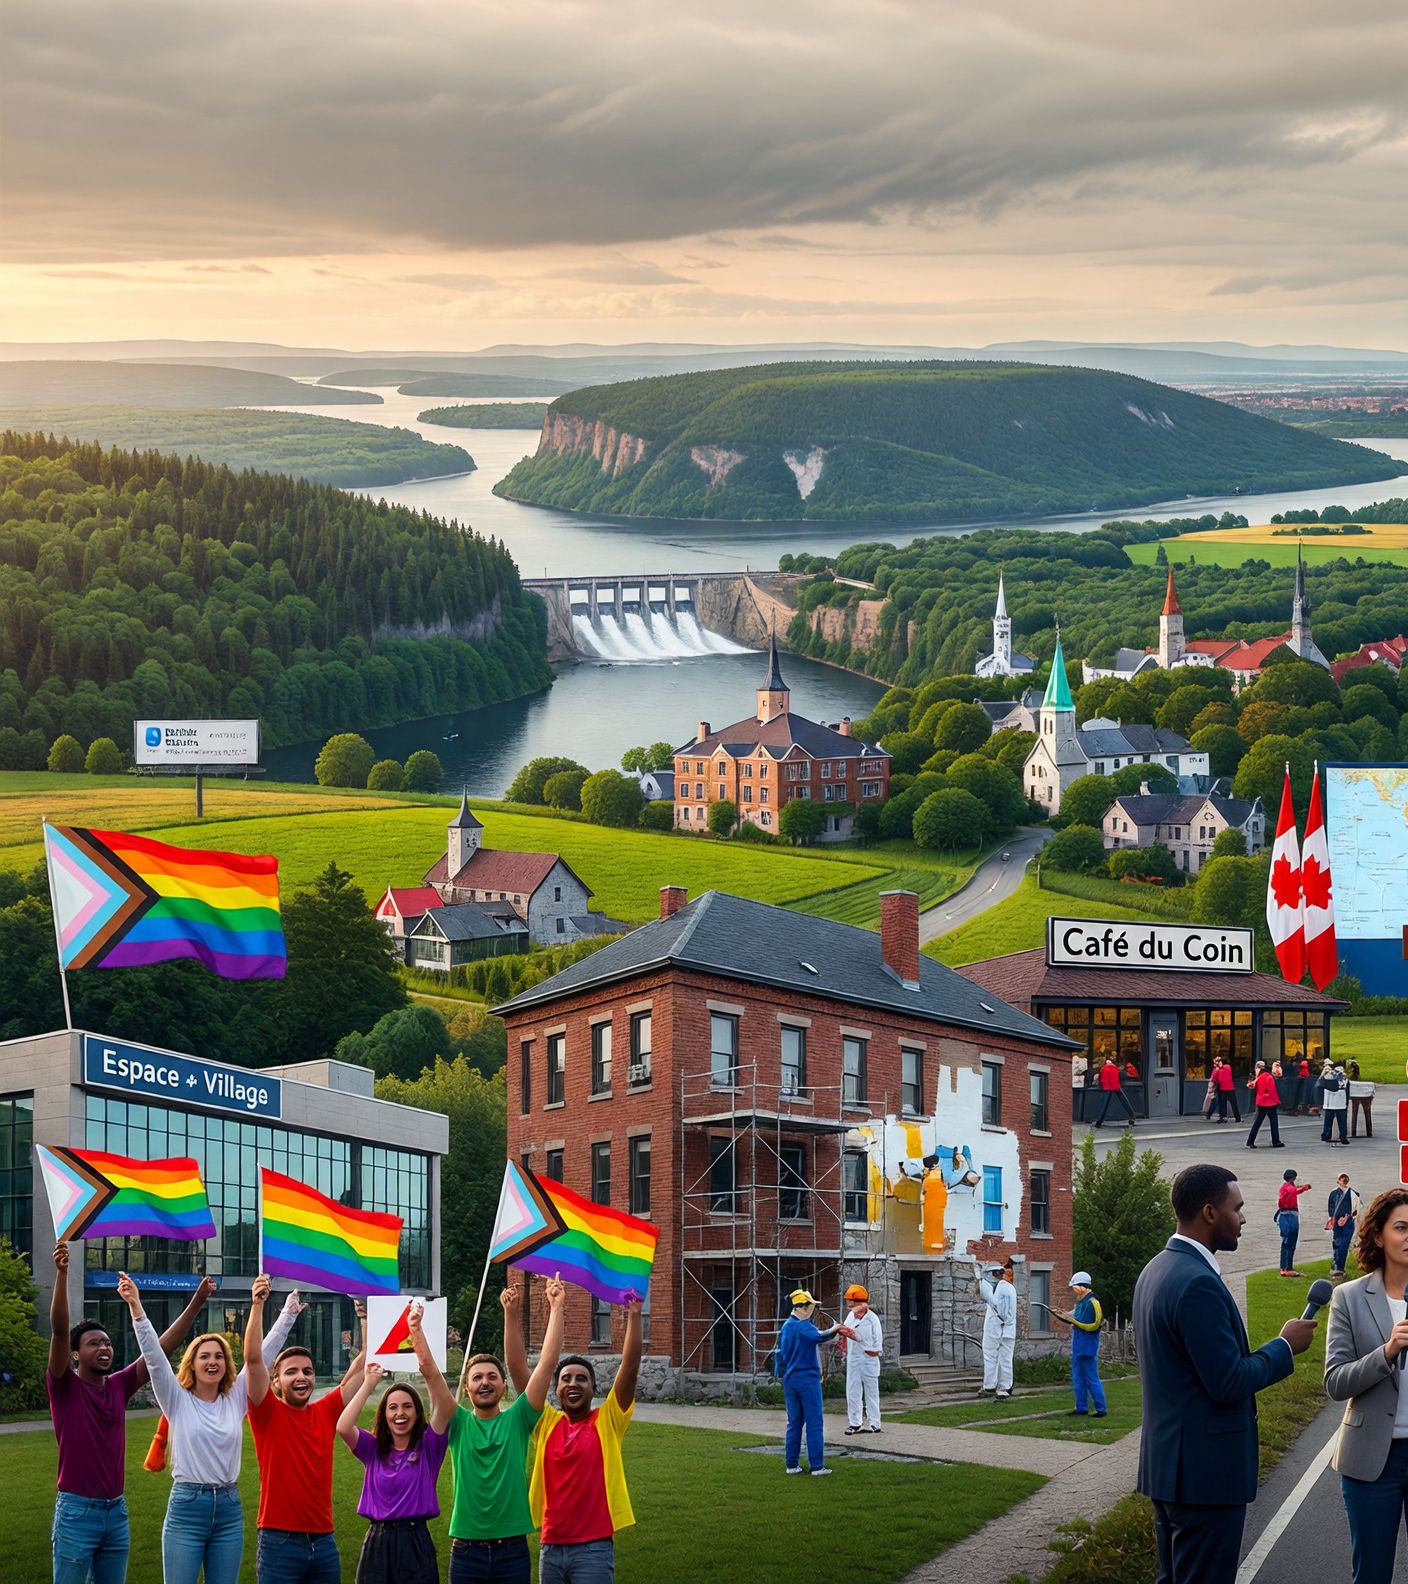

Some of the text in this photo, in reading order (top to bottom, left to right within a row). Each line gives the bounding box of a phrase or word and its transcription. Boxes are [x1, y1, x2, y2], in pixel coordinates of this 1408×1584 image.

[1062, 927, 1243, 963] Café du Coin
[102, 1048, 268, 1110] Espace Village
